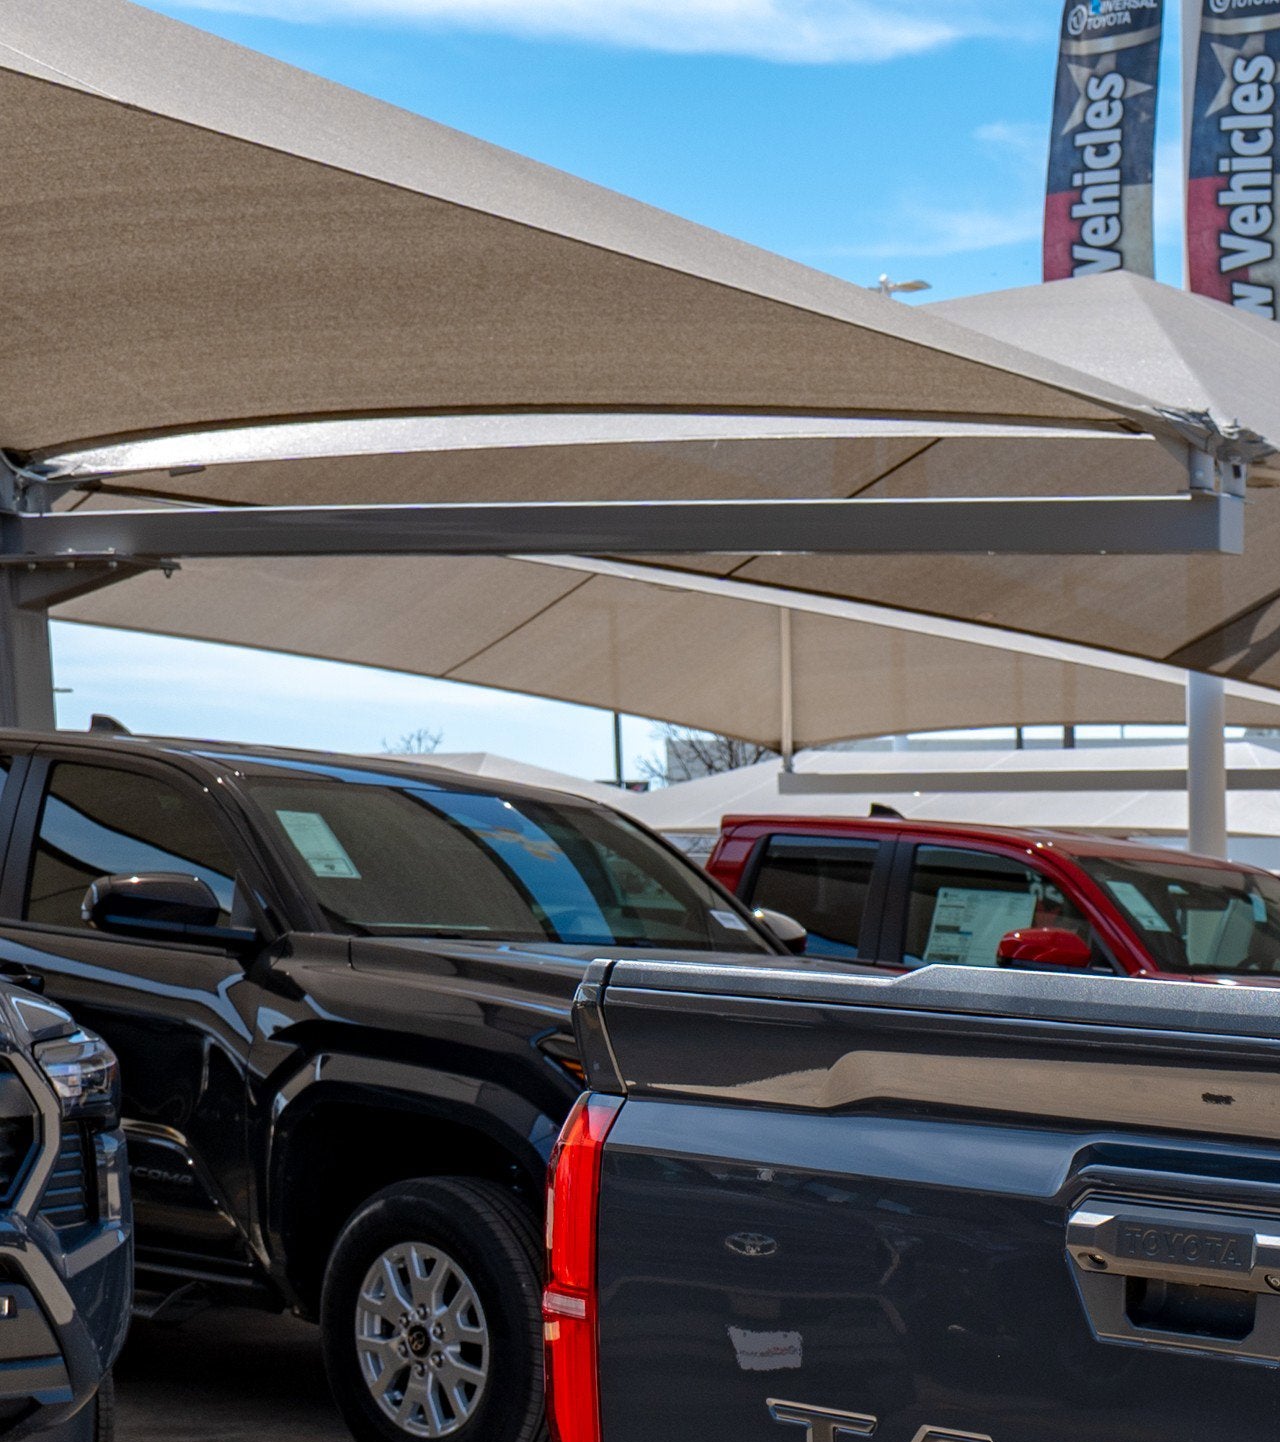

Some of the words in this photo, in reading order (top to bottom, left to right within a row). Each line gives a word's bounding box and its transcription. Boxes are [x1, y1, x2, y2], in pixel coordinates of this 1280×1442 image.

[1086, 11, 1132, 31] TOYOTA
[1071, 72, 1126, 278] Vehicles
[1218, 55, 1276, 273] Vehicles
[1124, 1226, 1243, 1267] TOYOTA
